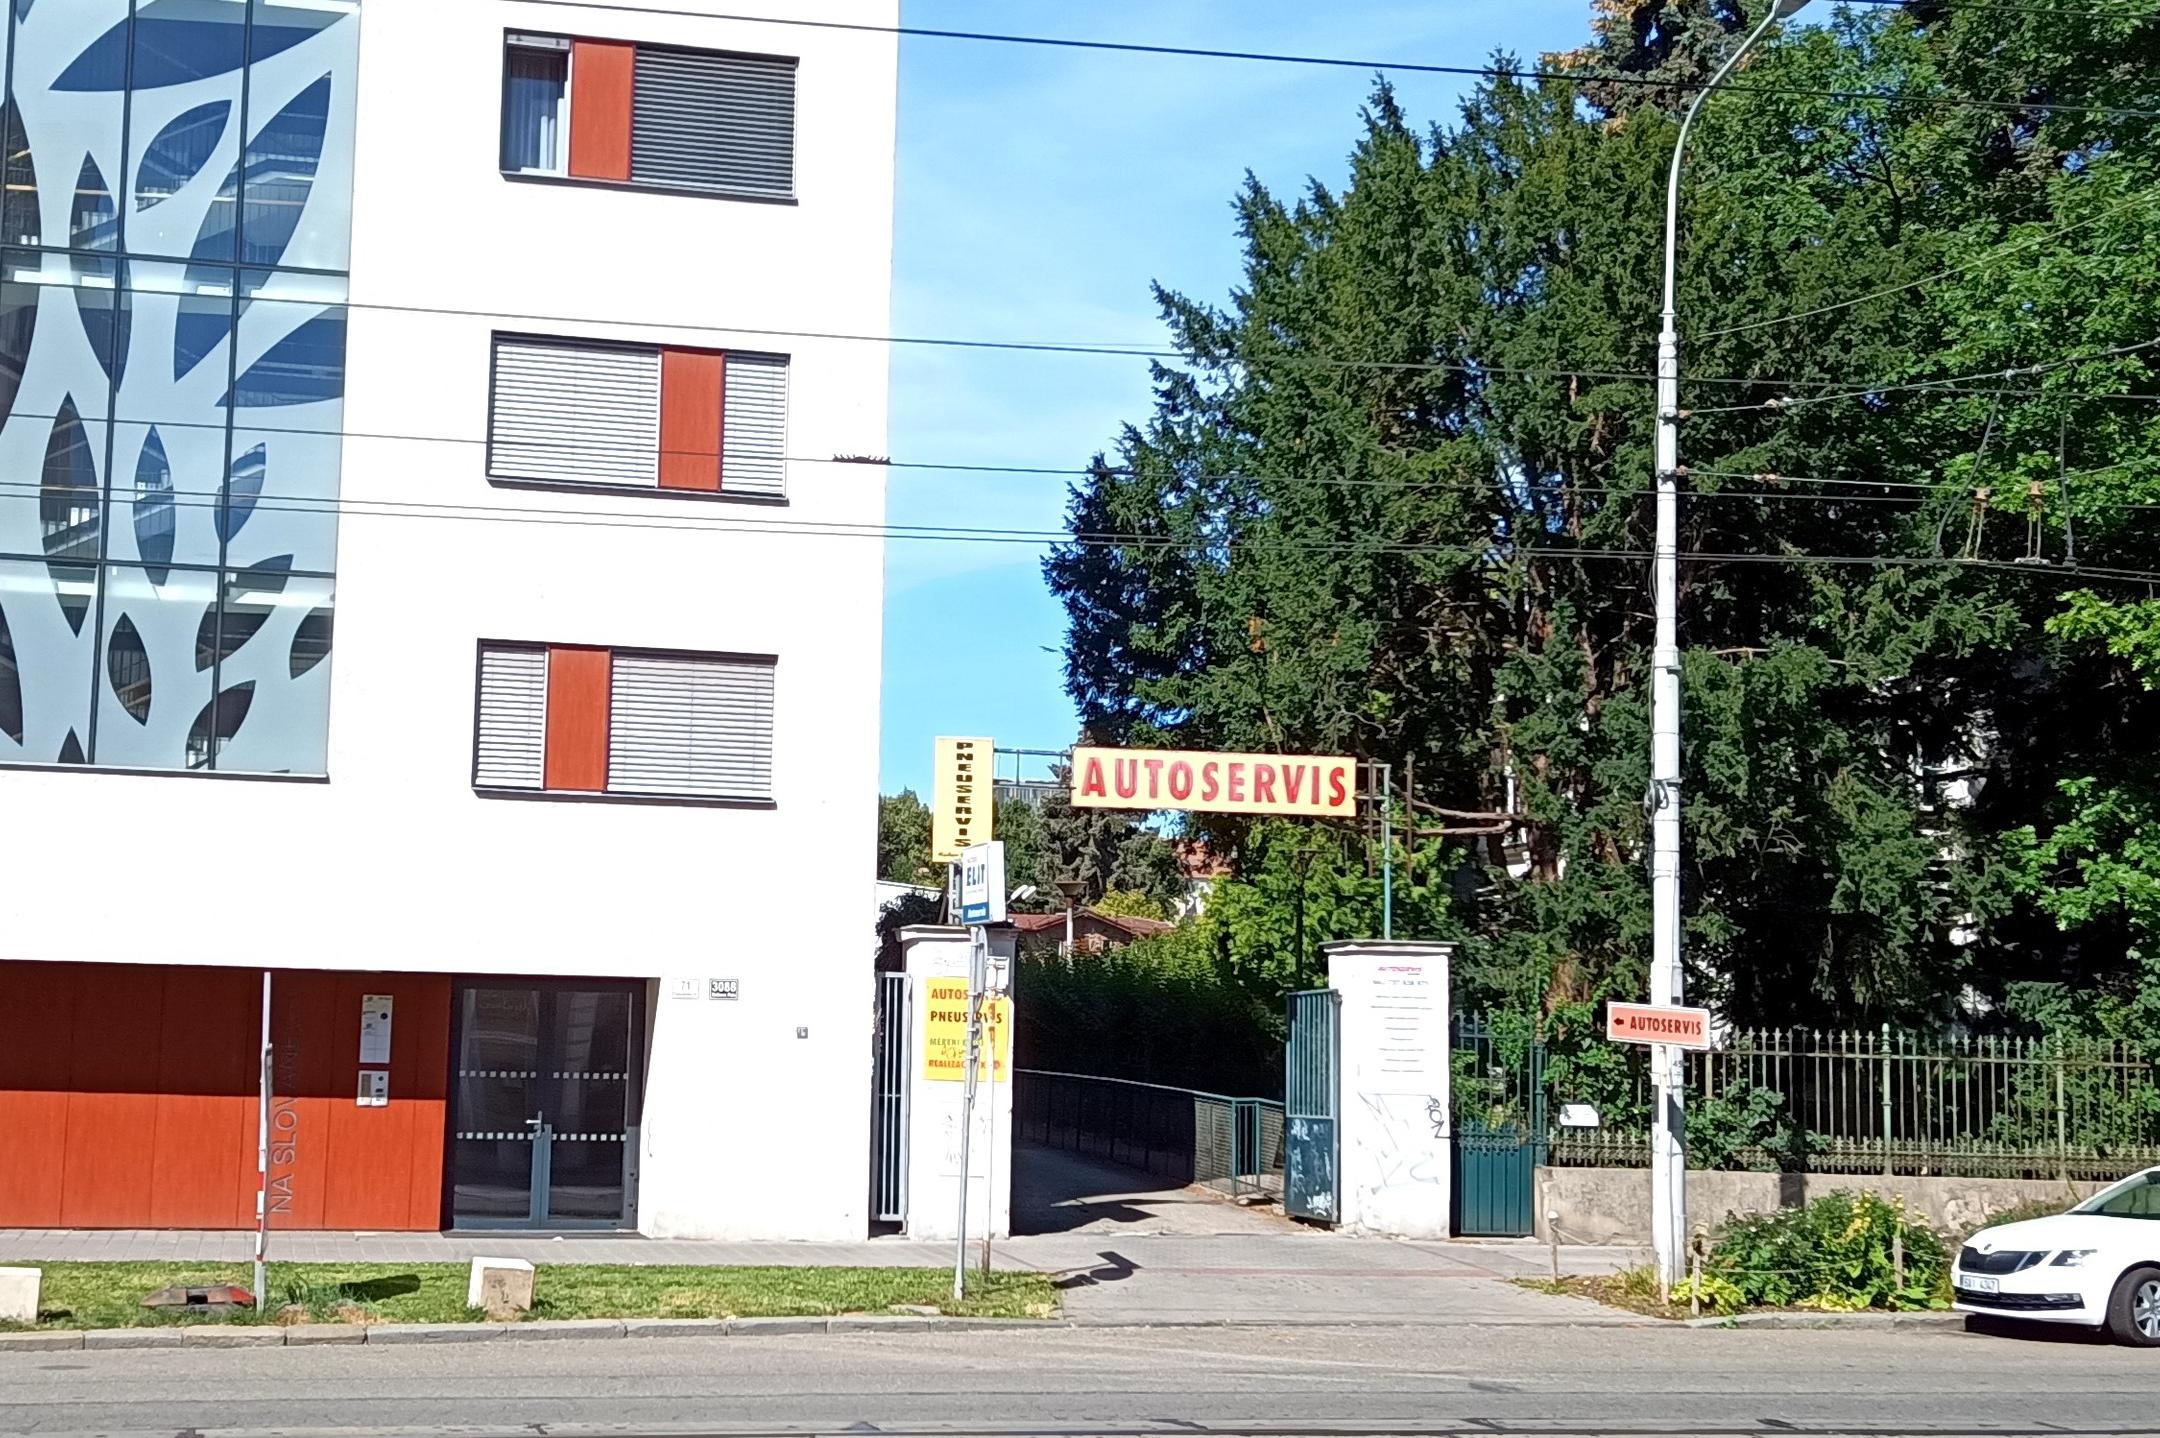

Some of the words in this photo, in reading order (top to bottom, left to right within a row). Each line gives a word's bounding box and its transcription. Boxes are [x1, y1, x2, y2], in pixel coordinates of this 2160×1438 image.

[954, 742, 973, 847] PNEUSERVIS
[1081, 757, 1347, 807] AUTOSERVIS
[966, 864, 985, 886] ELIT
[1630, 1016, 1702, 1035] AUTOSERVIS
[270, 1173, 294, 1213] NA
